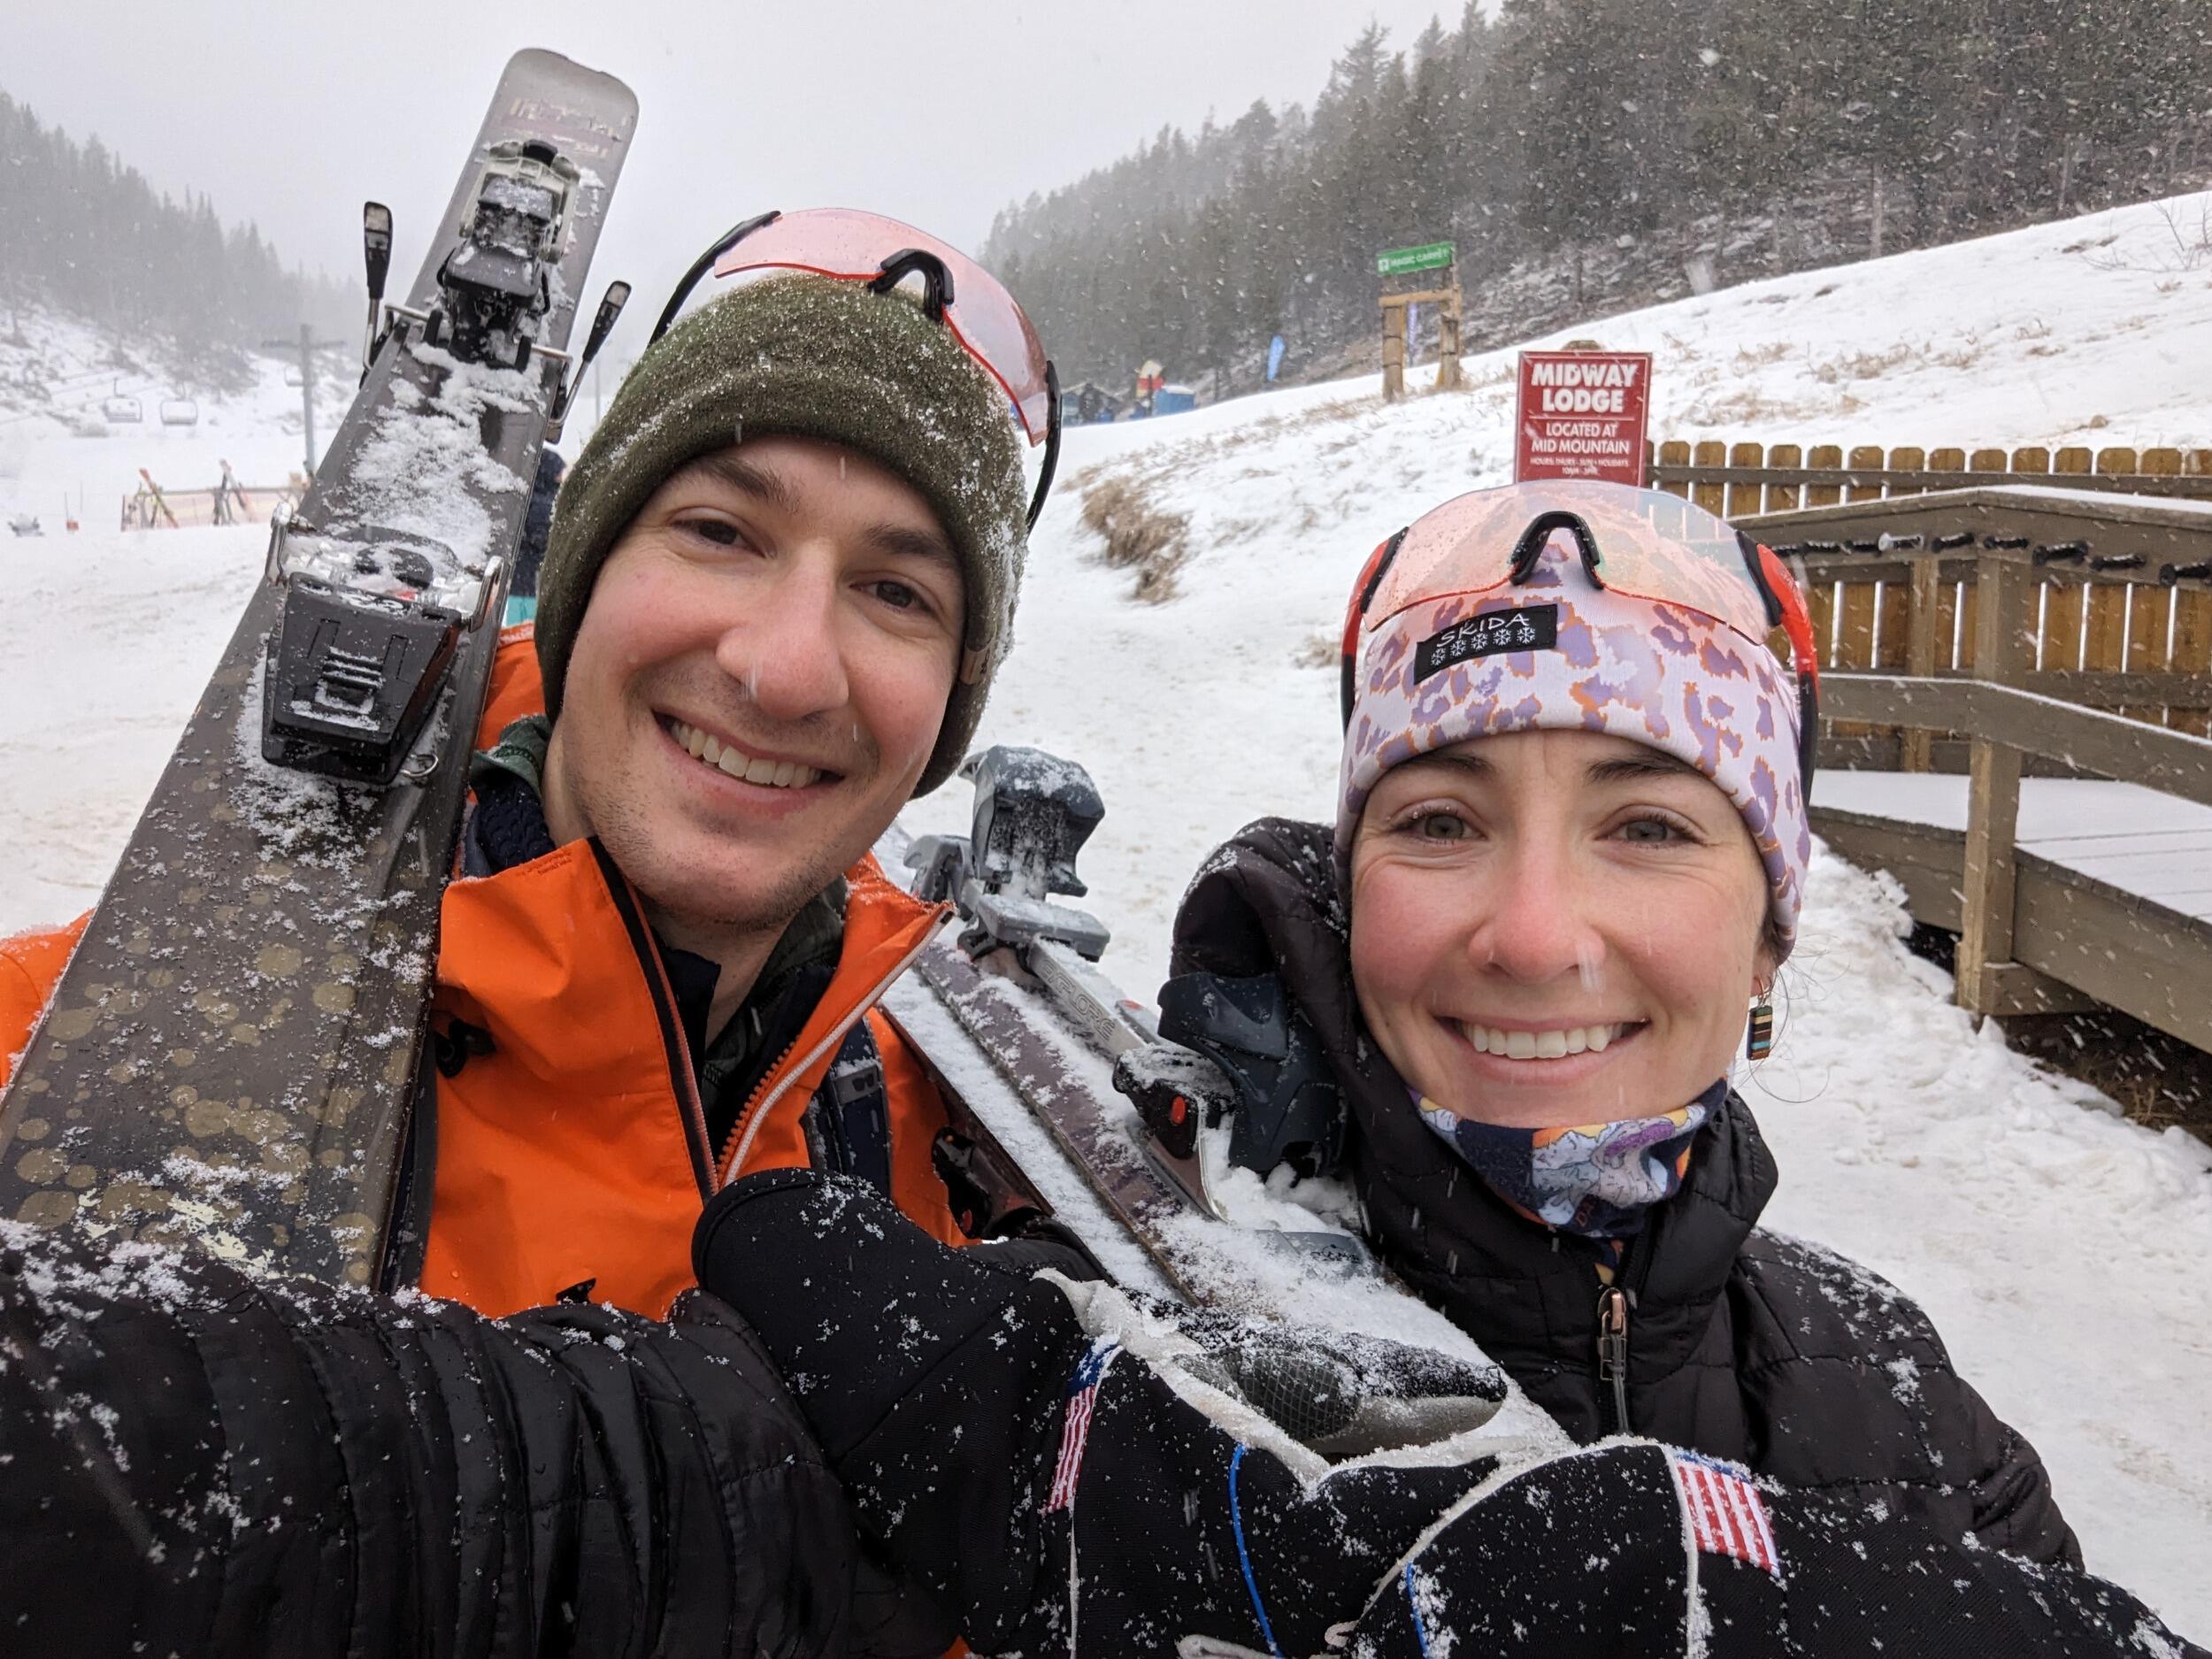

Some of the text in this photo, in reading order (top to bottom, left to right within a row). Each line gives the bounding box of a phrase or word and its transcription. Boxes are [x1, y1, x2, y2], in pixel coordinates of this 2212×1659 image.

[1532, 364, 1637, 387] MIDWAY
[1542, 389, 1624, 412] LODGE
[1546, 422, 1617, 437] LOCATED AT
[1532, 439, 1629, 455] MID MOUNTAIN
[1436, 613, 1529, 647] SKIDA
